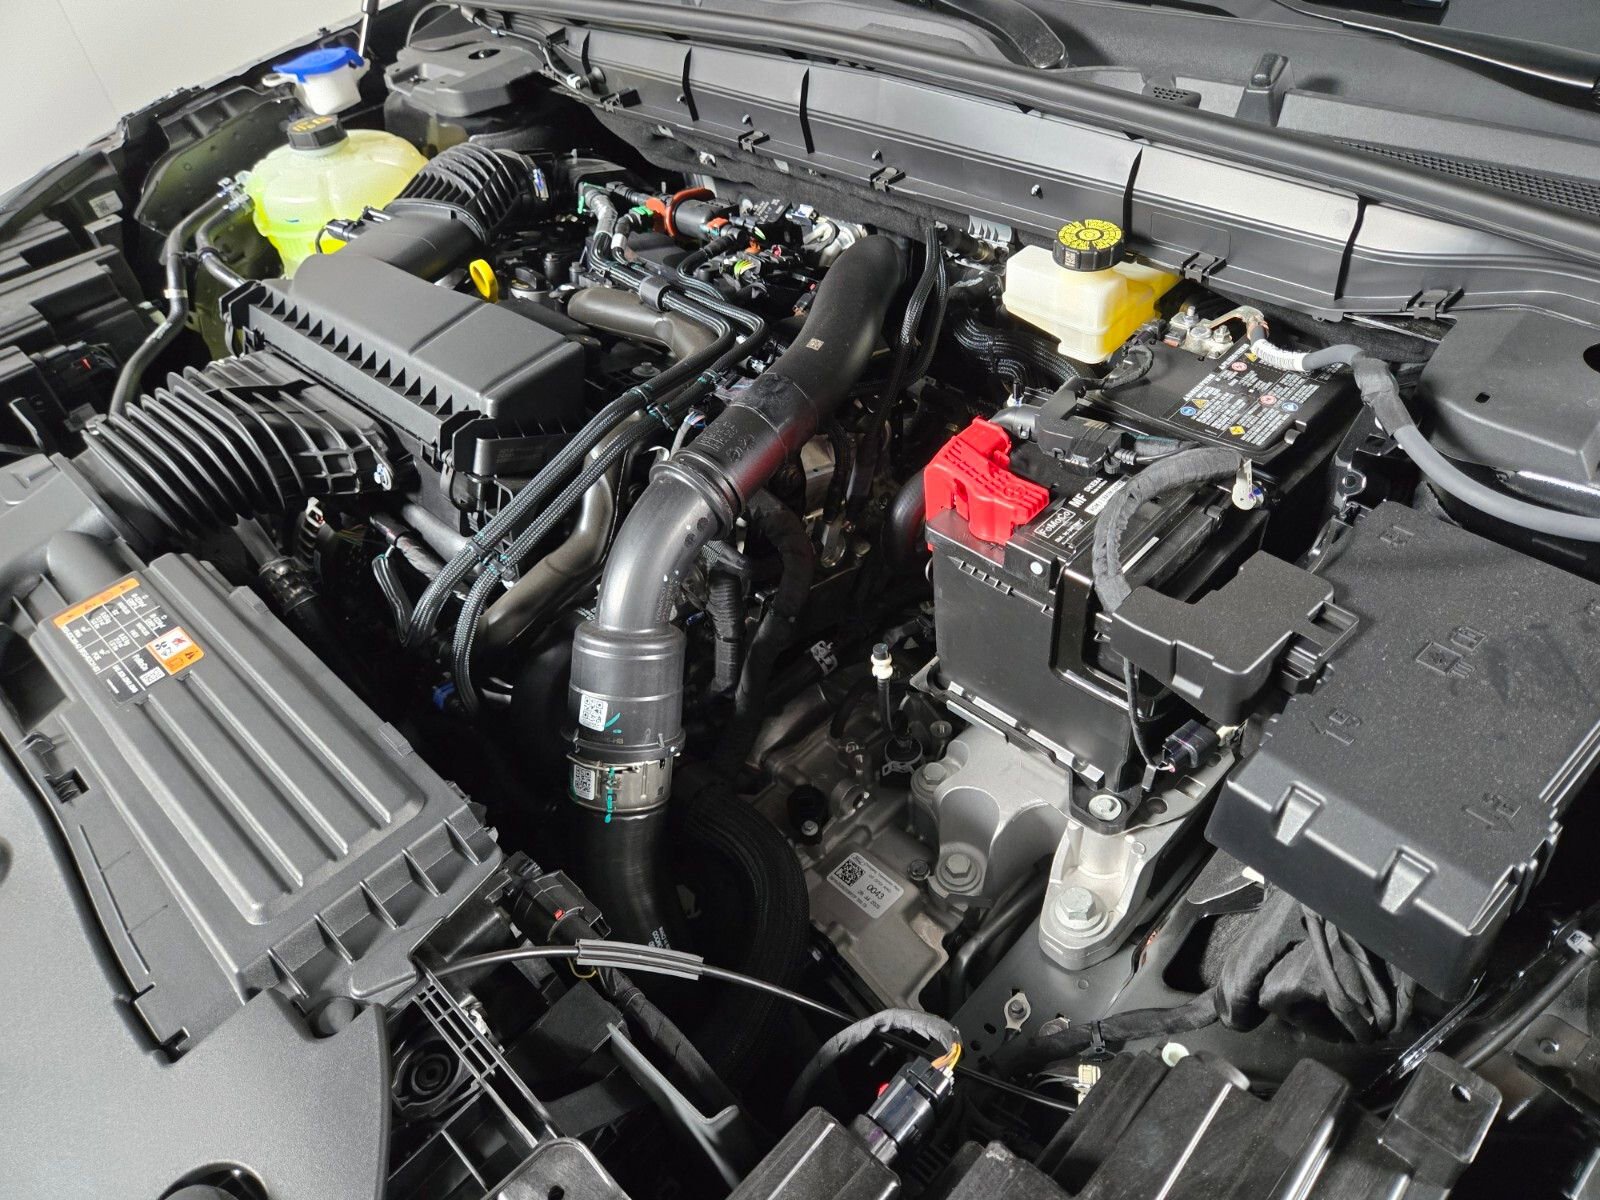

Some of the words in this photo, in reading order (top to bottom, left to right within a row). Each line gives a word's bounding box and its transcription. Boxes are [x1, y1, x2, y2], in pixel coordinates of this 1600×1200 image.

[1038, 510, 1071, 537] FoMoCo
[1068, 493, 1087, 508] MF
[866, 884, 885, 900] 0043
